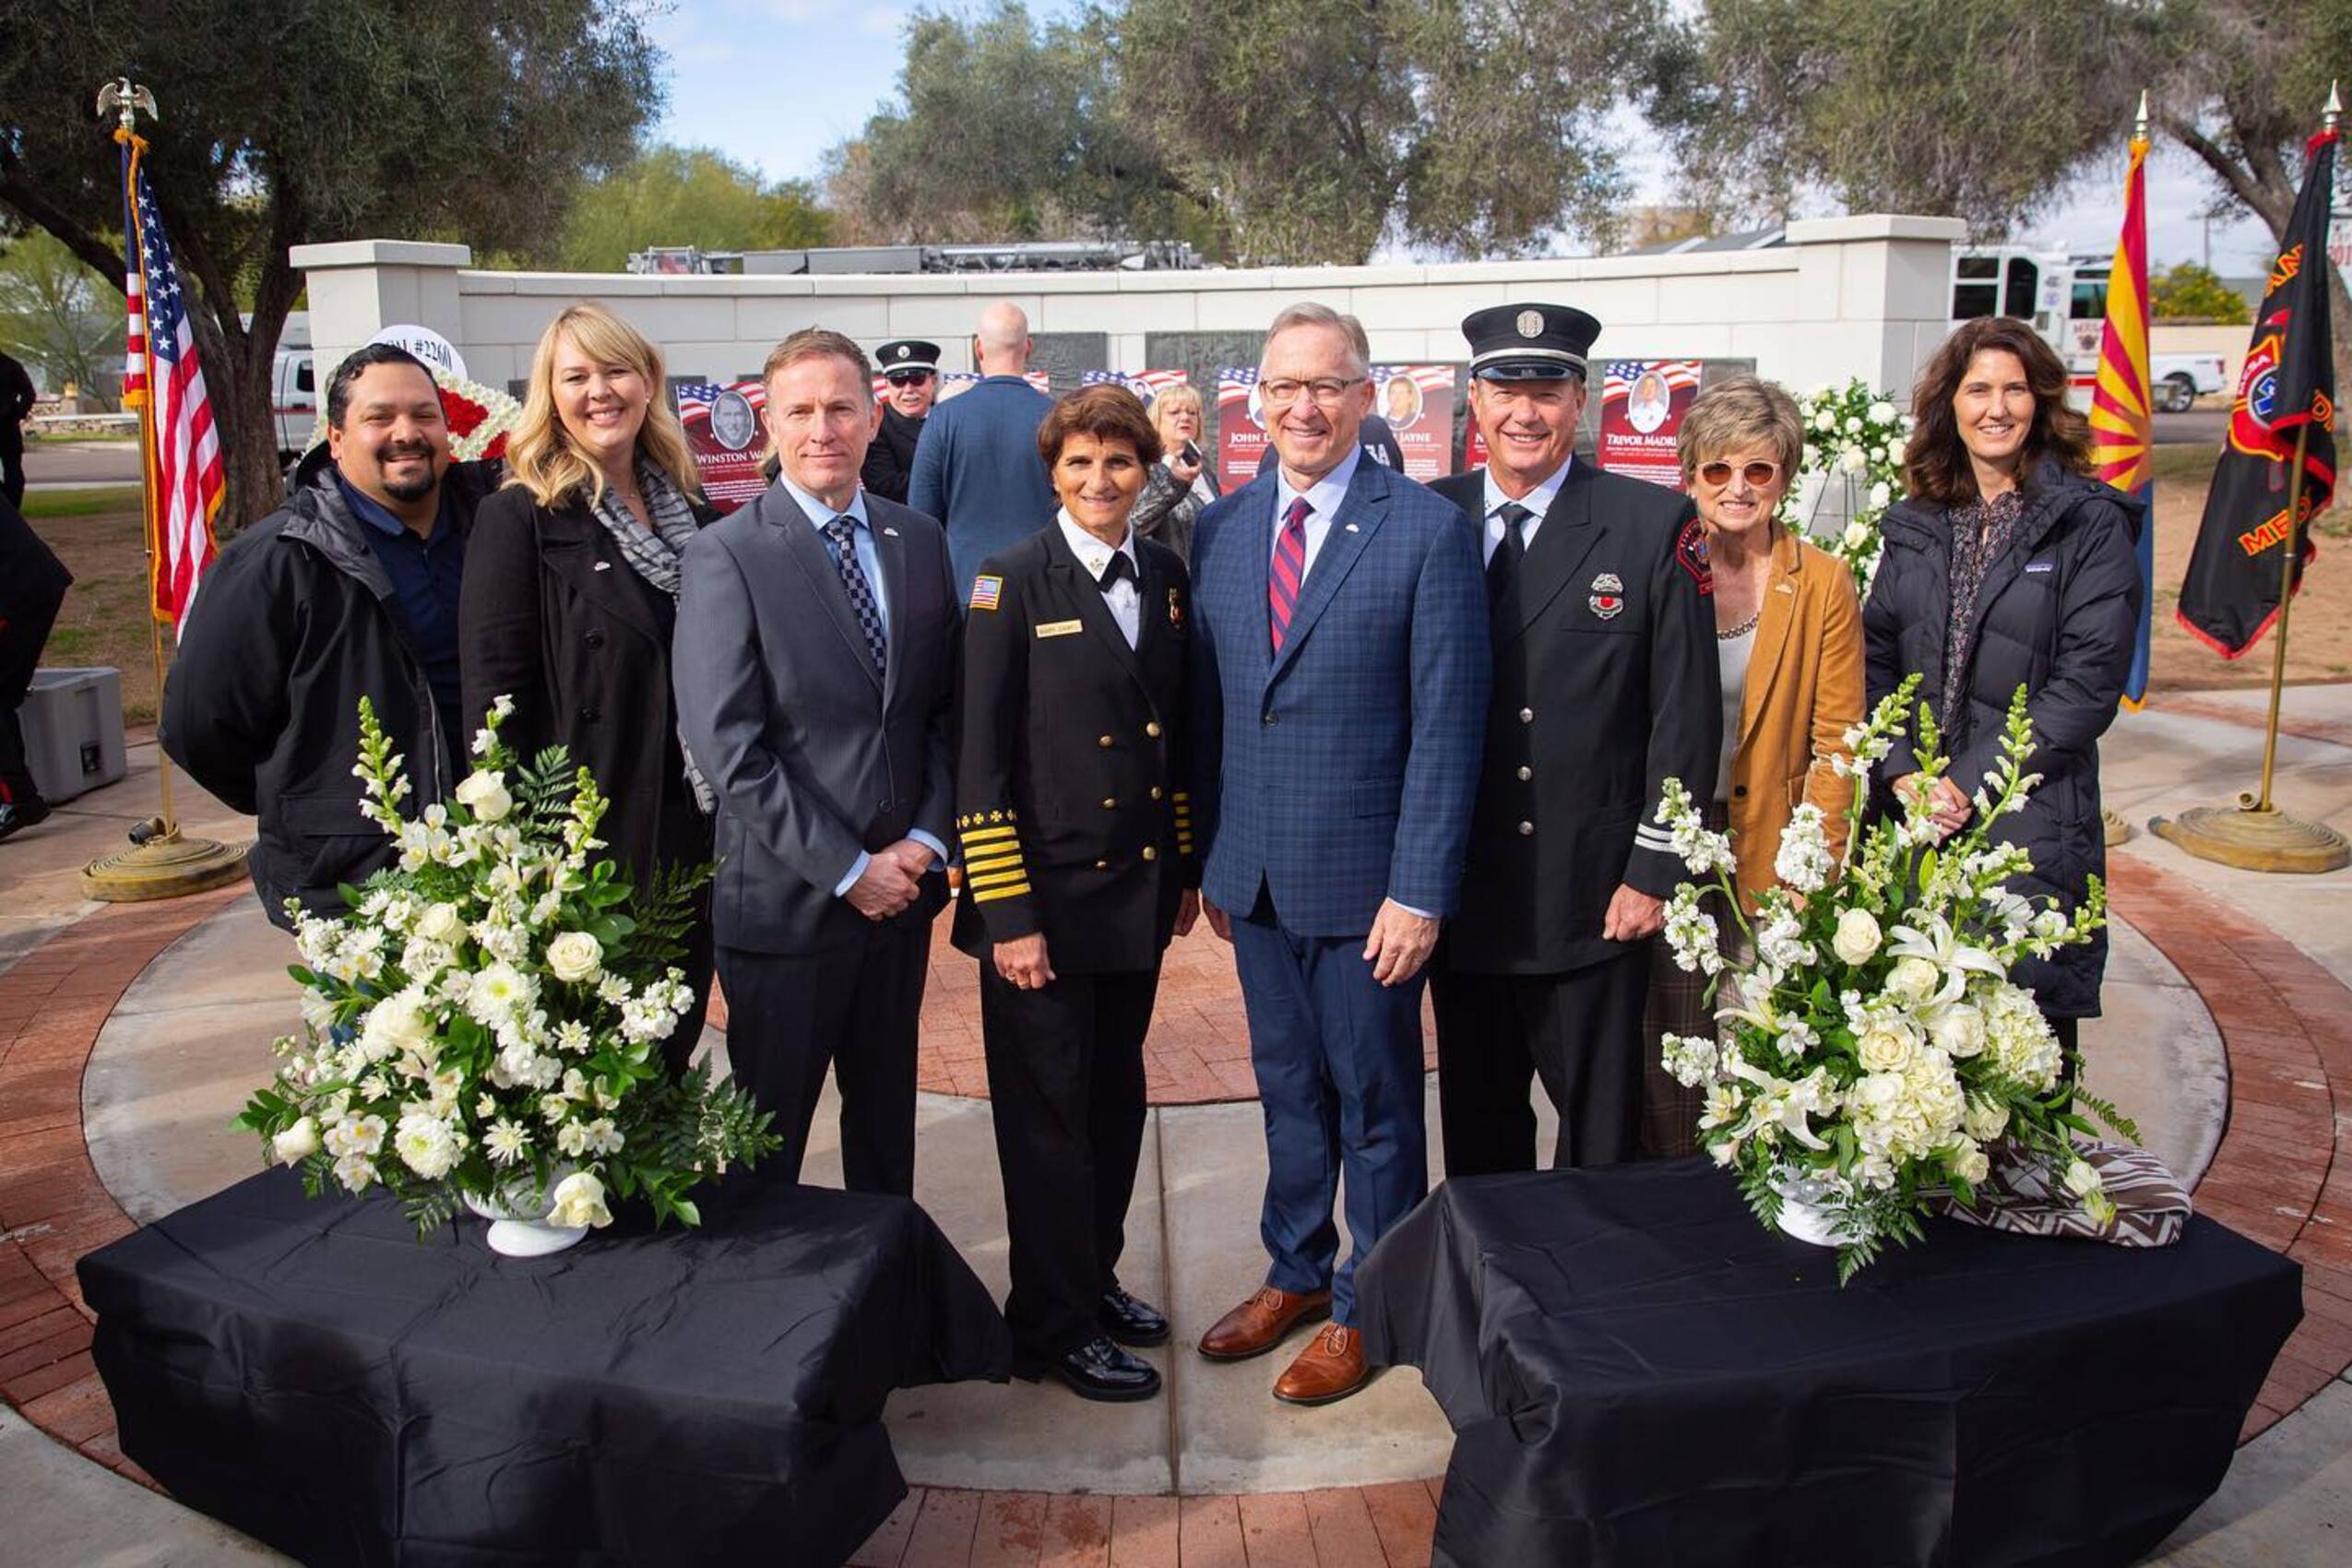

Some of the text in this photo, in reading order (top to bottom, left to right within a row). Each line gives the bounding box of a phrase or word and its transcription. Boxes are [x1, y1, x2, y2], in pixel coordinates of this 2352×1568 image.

[1230, 432, 1261, 444] JOHN
[1399, 431, 1431, 444] JAYNE
[1607, 434, 1643, 446] TREVOR
[695, 452, 747, 465] WINSTON
